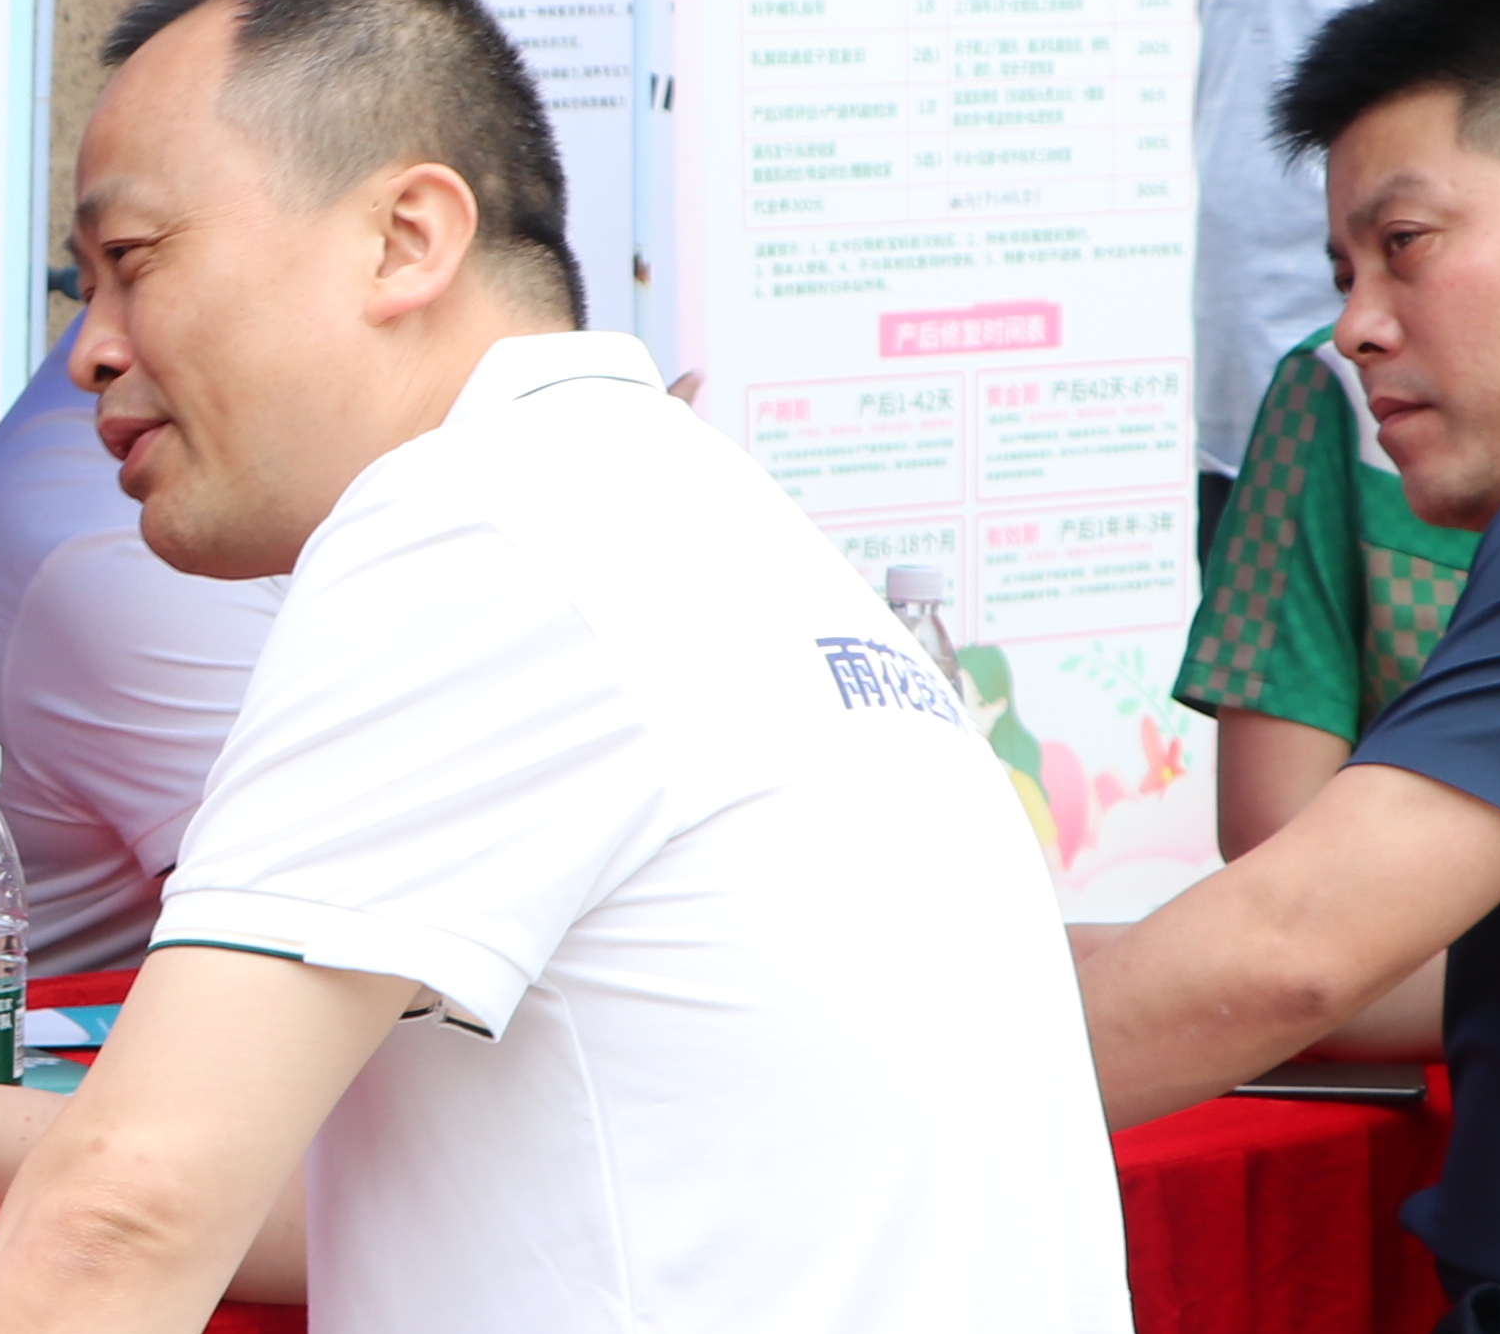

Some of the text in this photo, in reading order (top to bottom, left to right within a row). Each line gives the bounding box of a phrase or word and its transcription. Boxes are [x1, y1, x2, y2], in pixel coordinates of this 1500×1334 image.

[896, 314, 1046, 351] 产后修复时间表
